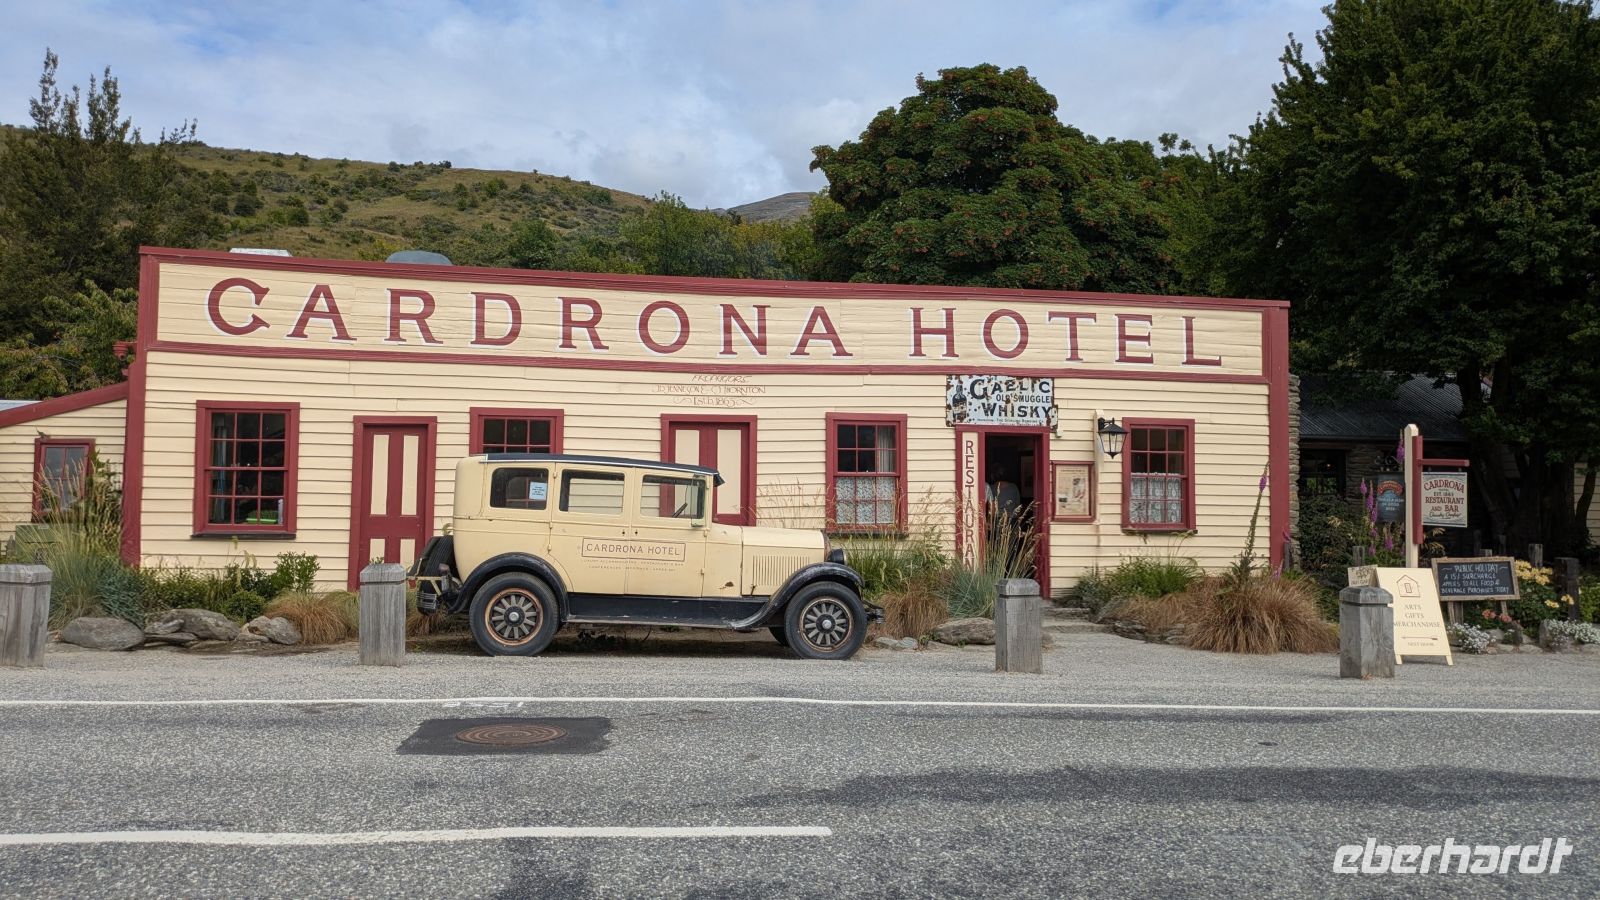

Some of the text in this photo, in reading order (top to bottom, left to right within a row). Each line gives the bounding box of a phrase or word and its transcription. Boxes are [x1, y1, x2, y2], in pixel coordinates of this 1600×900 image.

[206, 277, 1223, 367] CARDRONA HOTEL
[969, 378, 1051, 400] GAELIC
[1013, 393, 1053, 404] SMUGGLE
[981, 402, 1052, 418] WHISKY
[1423, 479, 1465, 493] CARDRONA
[965, 440, 975, 573] RESTAURAN
[1425, 496, 1465, 504] RESTAURANT
[1444, 504, 1460, 512] BAR
[586, 543, 681, 556] CARDRONA HOTEL
[1454, 564, 1498, 573] PUBLIC HOLIDAY
